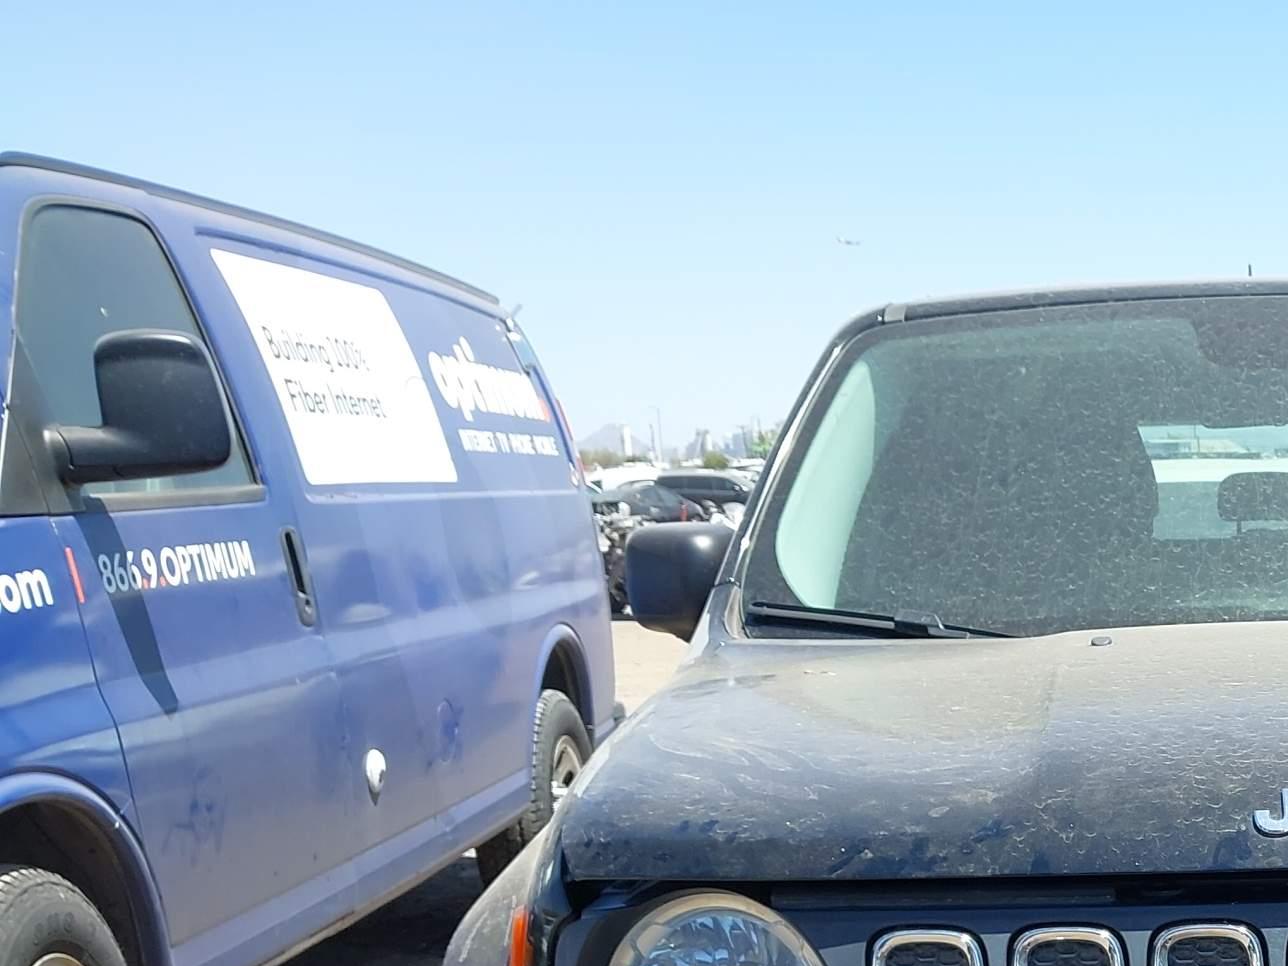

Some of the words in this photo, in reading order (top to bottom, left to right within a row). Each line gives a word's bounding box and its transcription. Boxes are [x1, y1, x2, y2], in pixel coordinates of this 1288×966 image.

[261, 325, 334, 372] Building
[326, 336, 370, 372] 100%
[284, 378, 329, 414] Fiber
[326, 383, 387, 418] Internet
